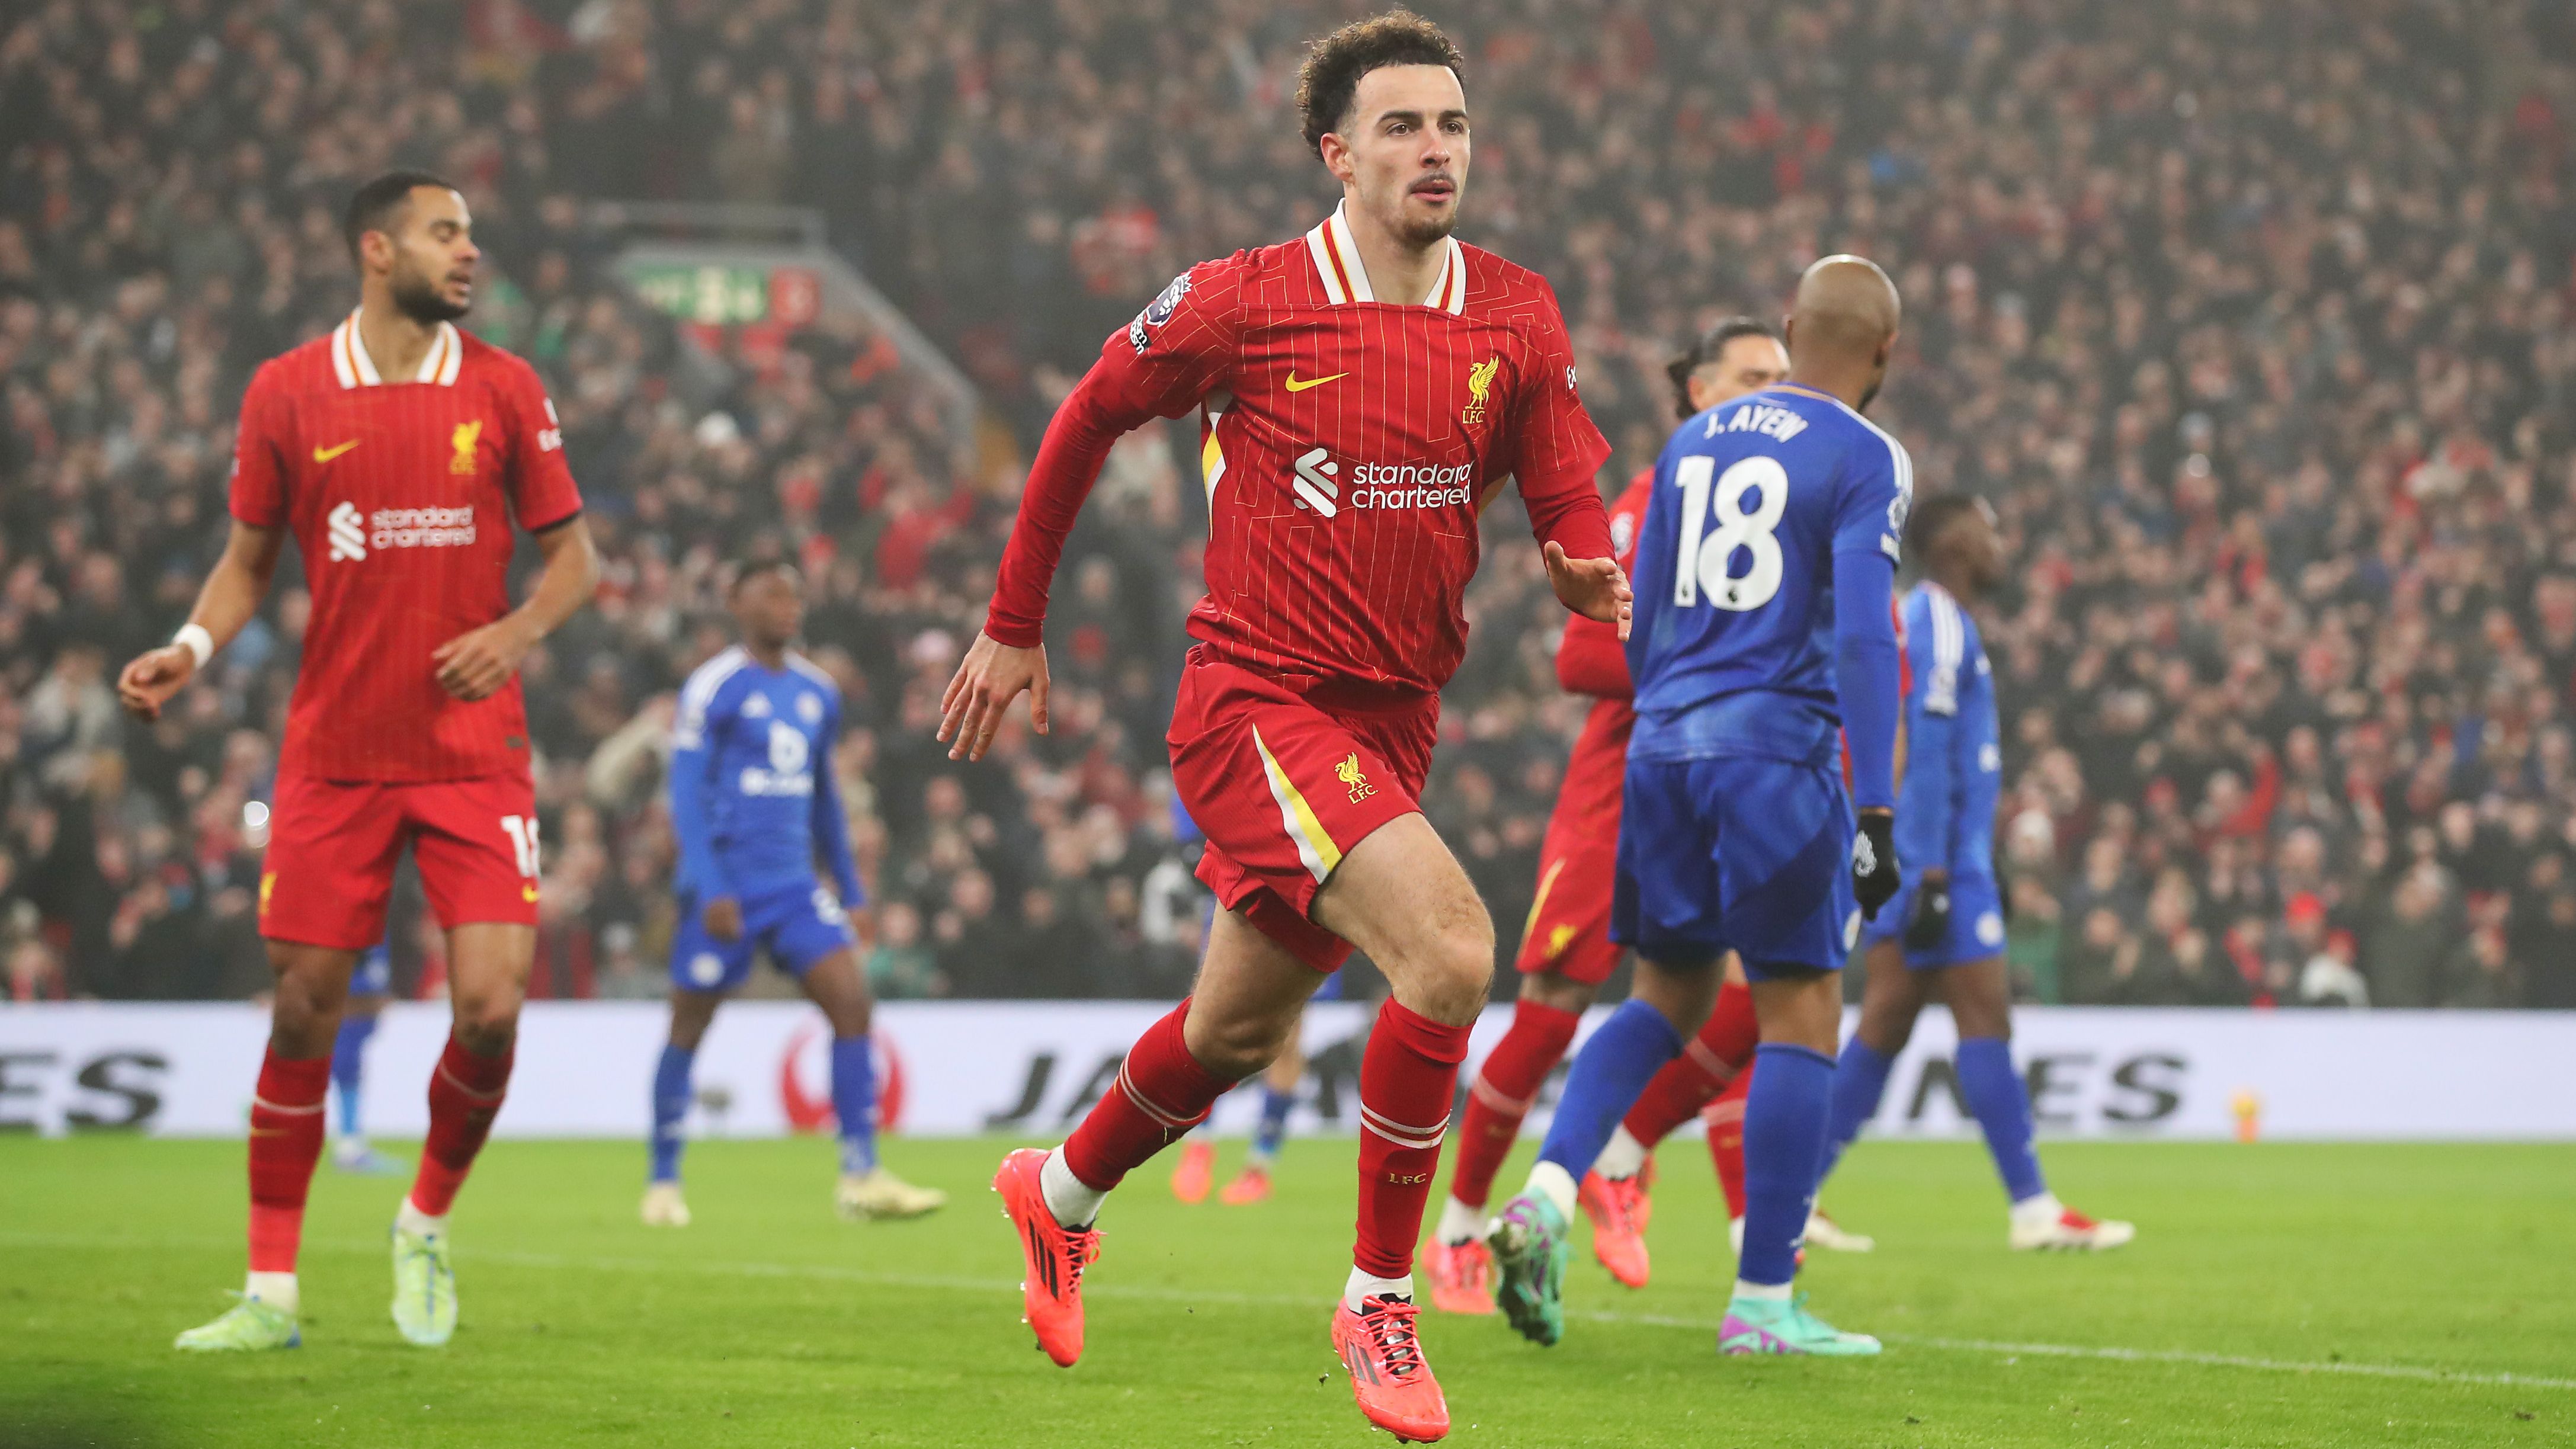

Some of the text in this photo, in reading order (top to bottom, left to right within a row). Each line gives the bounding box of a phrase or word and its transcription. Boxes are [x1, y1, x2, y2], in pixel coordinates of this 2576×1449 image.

[1353, 460, 1475, 485] standard
[1351, 479, 1472, 509] chartered
[1674, 455, 1789, 612] 18
[1389, 1172, 1427, 1184] LFC
